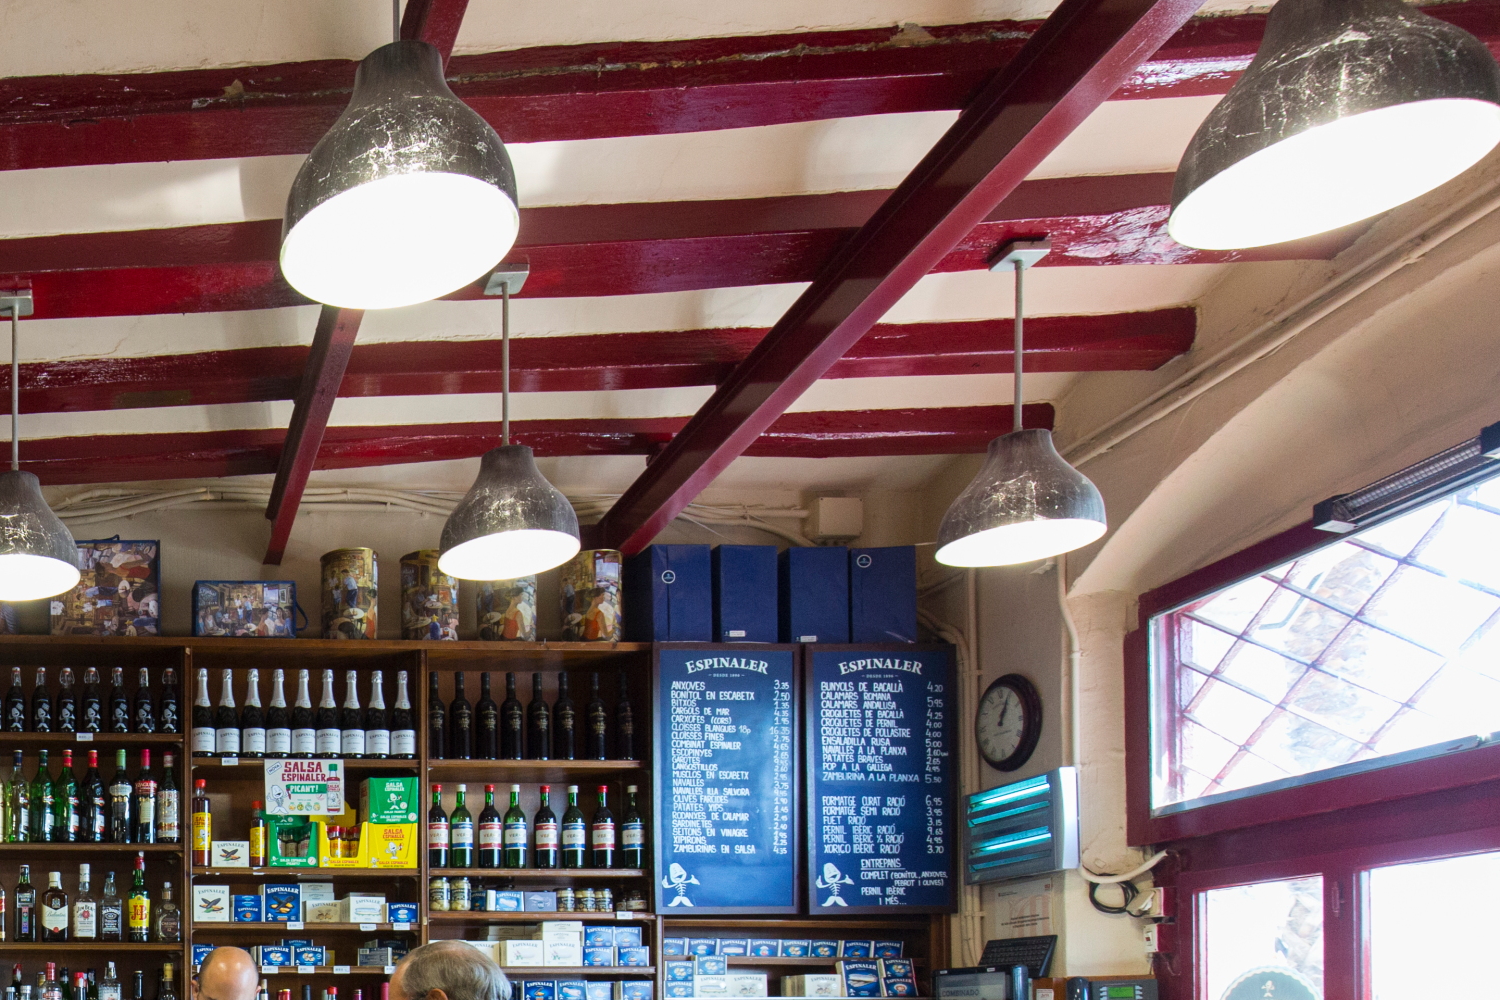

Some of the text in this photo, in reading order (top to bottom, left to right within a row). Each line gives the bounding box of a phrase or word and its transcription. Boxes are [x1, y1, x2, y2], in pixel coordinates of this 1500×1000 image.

[685, 657, 768, 674] ESPINALER
[838, 658, 922, 675] ESPINALER
[671, 680, 789, 691] ANXOVES 3.35
[820, 680, 943, 692] BUNYOLS DE BACALLÀ 4.20
[706, 692, 715, 700] EN
[720, 692, 755, 700] ESCABETX
[821, 692, 891, 701] CALAMARS ROMANA
[821, 697, 943, 710] CALAMARS ANDALUSA 5.95
[716, 708, 730, 716] MAR
[821, 709, 943, 720] CROQUETES DE BACALLÀ 4.25
[671, 716, 705, 724] CARXOFES
[821, 719, 942, 728] CROQUETES PERNIL 4.00
[705, 733, 724, 741] FINES
[821, 727, 911, 738] CROQUETES POLLASTRE
[672, 740, 741, 750] COMBINAT ESPINALER
[822, 737, 942, 748] ENSALADILLA RUSA 5.00
[672, 748, 712, 757] ESCOPINYES
[822, 746, 907, 756] NAVALLES LA PLANXA
[823, 754, 883, 763] PATATES BRAVES
[284, 762, 322, 772] SALSA
[852, 763, 860, 771] LA
[867, 763, 893, 771] GALLEGA
[282, 773, 326, 782] ESPINALER
[672, 771, 749, 780] MUSCLOS ESCABETX
[876, 773, 886, 781] LA
[889, 774, 919, 782] PLANXA
[672, 779, 704, 787] NAVALLES
[673, 795, 698, 803] OLIVES
[822, 796, 856, 806] FORMATGE
[926, 795, 942, 806] 6.95
[673, 804, 724, 812] PATATES XIPS
[823, 806, 856, 815] FORMATGE
[861, 806, 877, 816] SEMI
[672, 812, 749, 821] RODANXES DE CALAMAR
[823, 816, 942, 826] FUET 3.15
[672, 820, 712, 828] SARDINETES
[672, 828, 749, 837] SEITONS VINAGRE
[823, 826, 847, 835] PERNIL
[673, 836, 706, 844] XIPIRONS
[823, 835, 847, 843] PERNIL
[721, 844, 756, 854] EN SALSA
[927, 844, 944, 854] 3.70
[861, 859, 901, 868] ENTREPANS
[861, 871, 889, 880] COMPLET
[861, 887, 882, 895] PERNIL
[131, 904, 147, 921] J&B
[942, 989, 979, 997] COMBINADO
